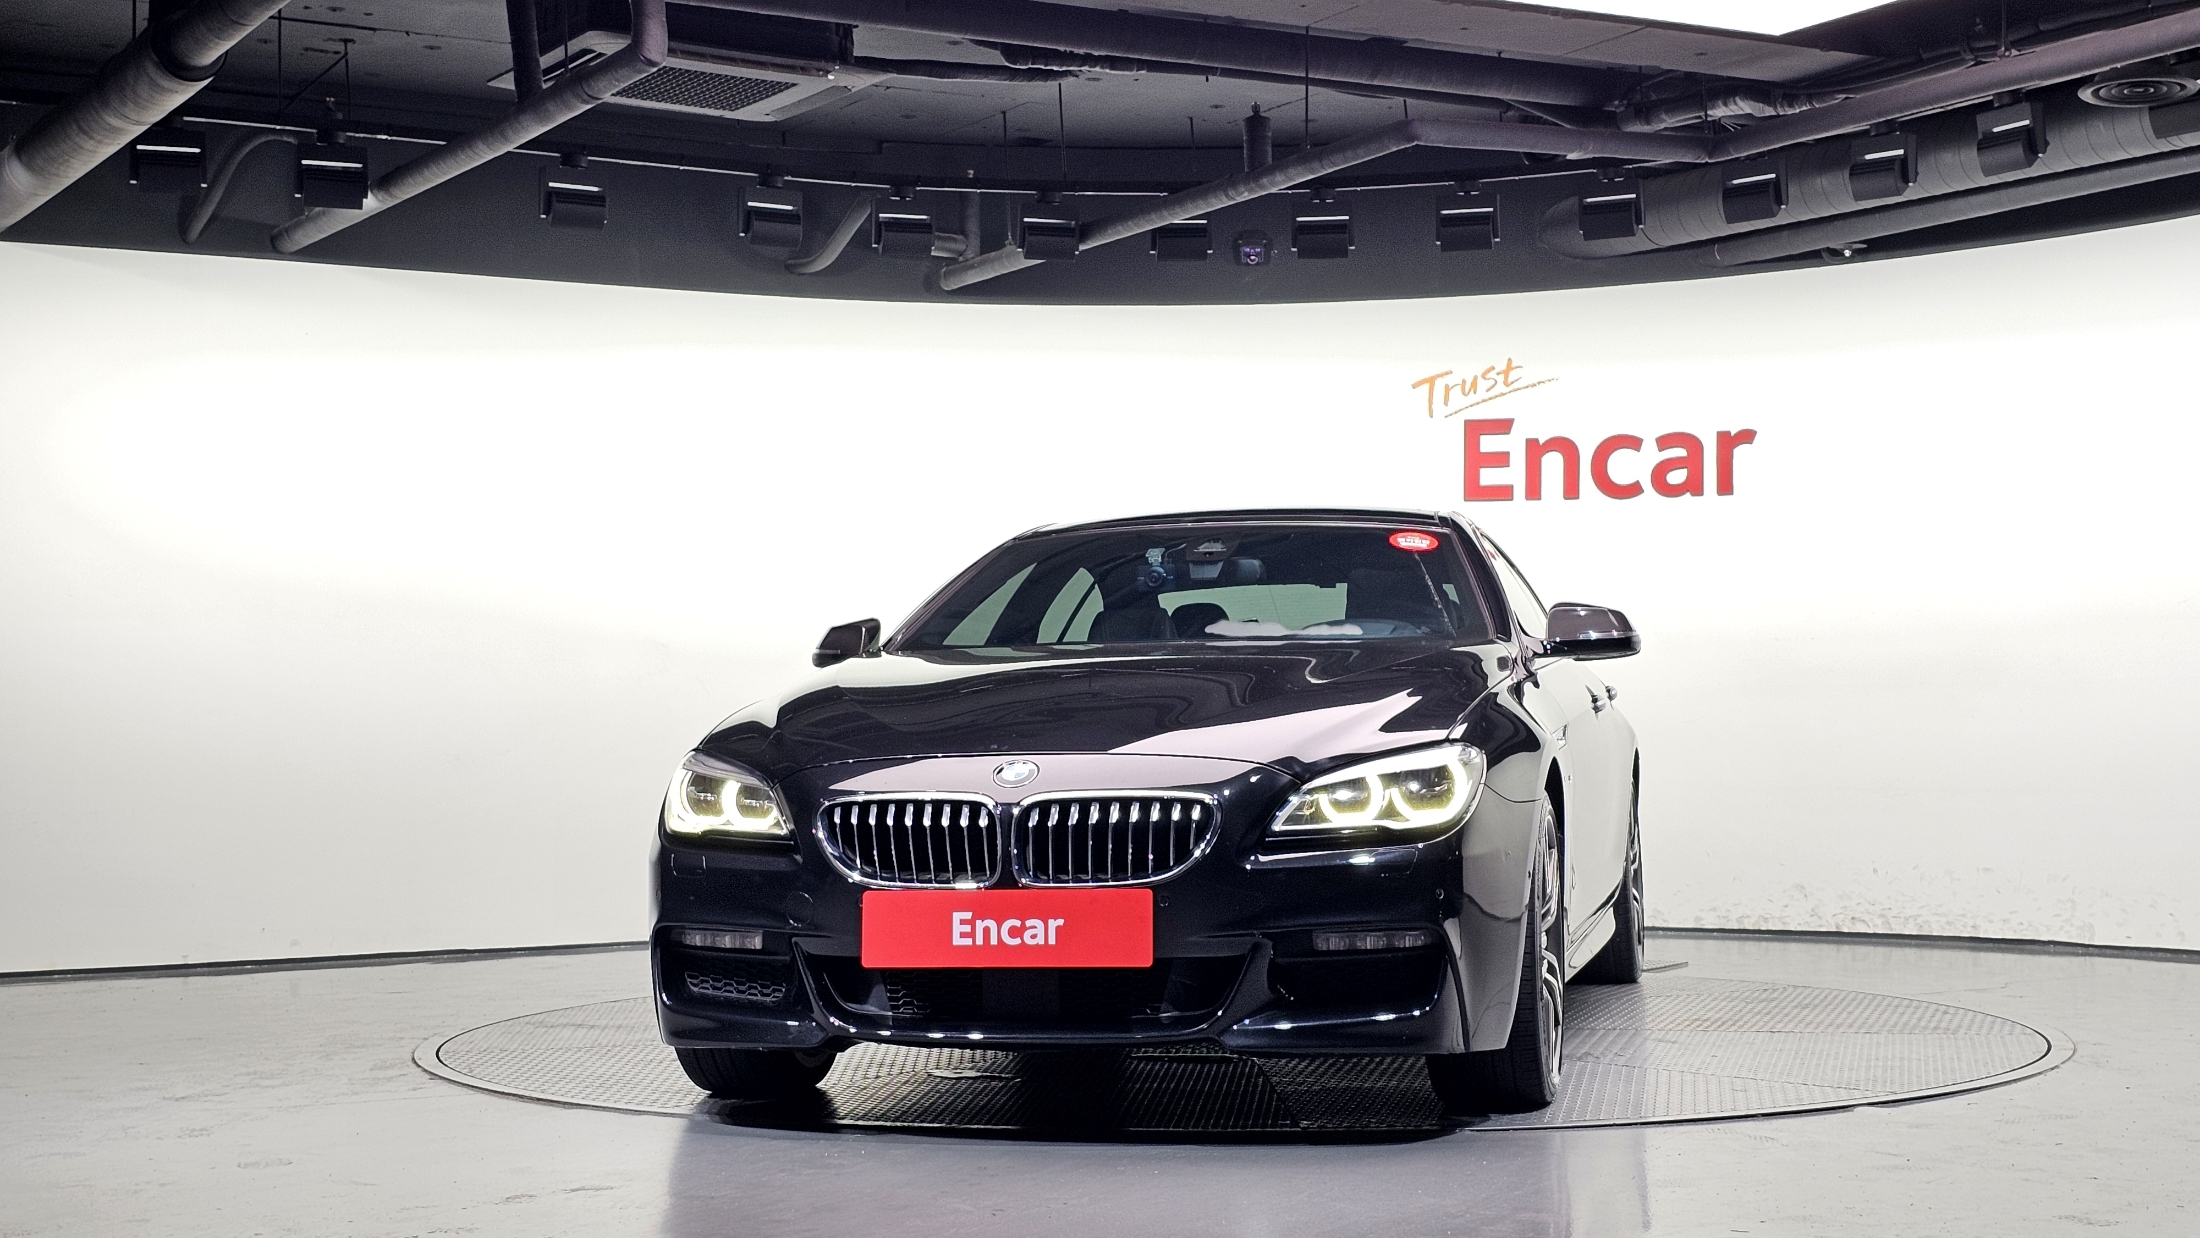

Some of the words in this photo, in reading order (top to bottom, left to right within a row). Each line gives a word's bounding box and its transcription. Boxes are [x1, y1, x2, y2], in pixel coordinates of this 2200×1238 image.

[1411, 357, 1524, 419] Trust
[1463, 417, 1758, 502] Encar
[952, 911, 1065, 946] Encar
